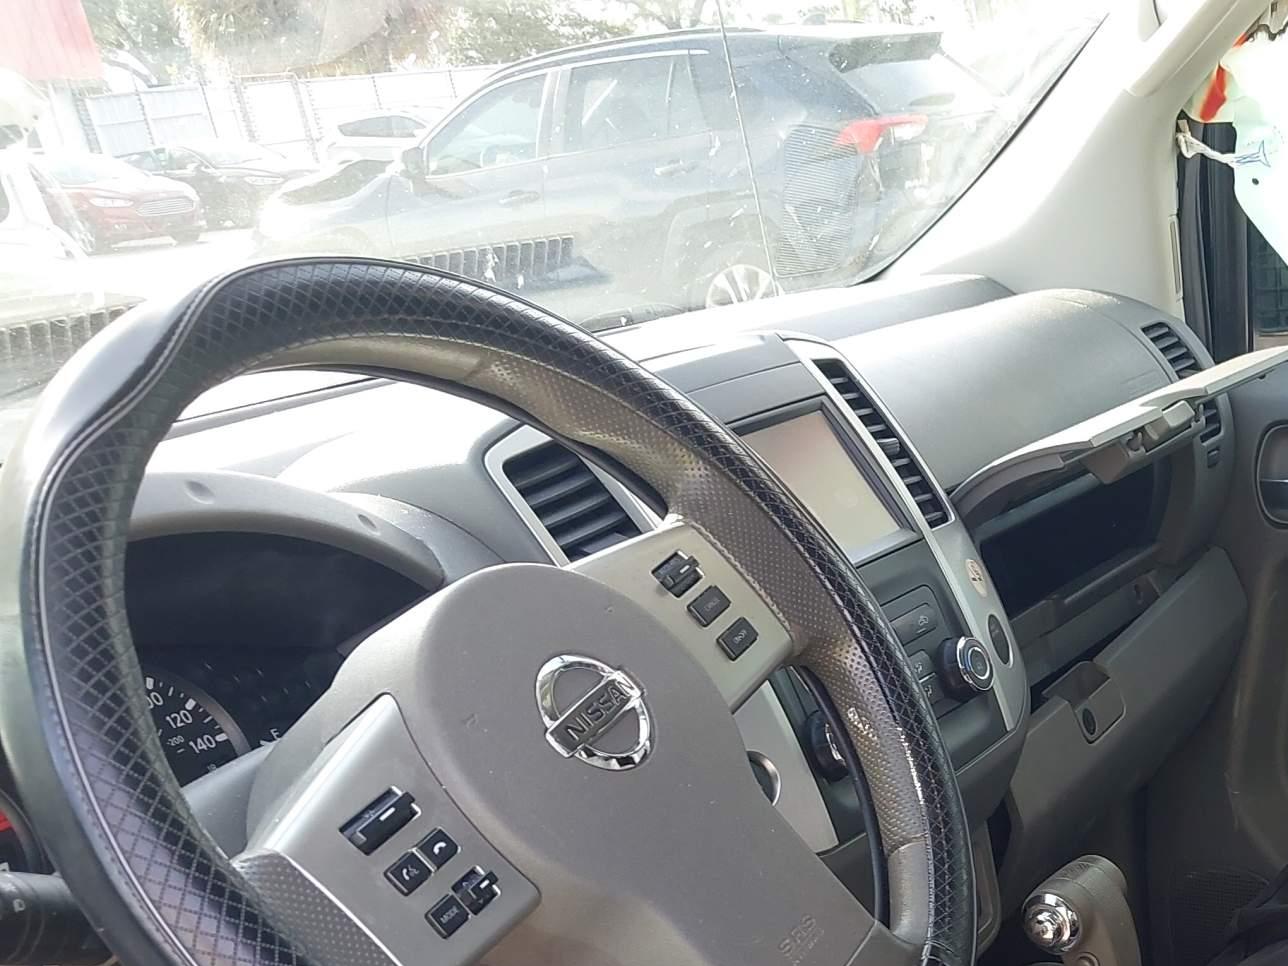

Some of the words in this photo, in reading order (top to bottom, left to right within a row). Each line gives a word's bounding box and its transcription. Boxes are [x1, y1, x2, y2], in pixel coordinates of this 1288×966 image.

[165, 709, 193, 729] 120
[563, 676, 636, 742] NISSAN
[188, 733, 217, 754] 140
